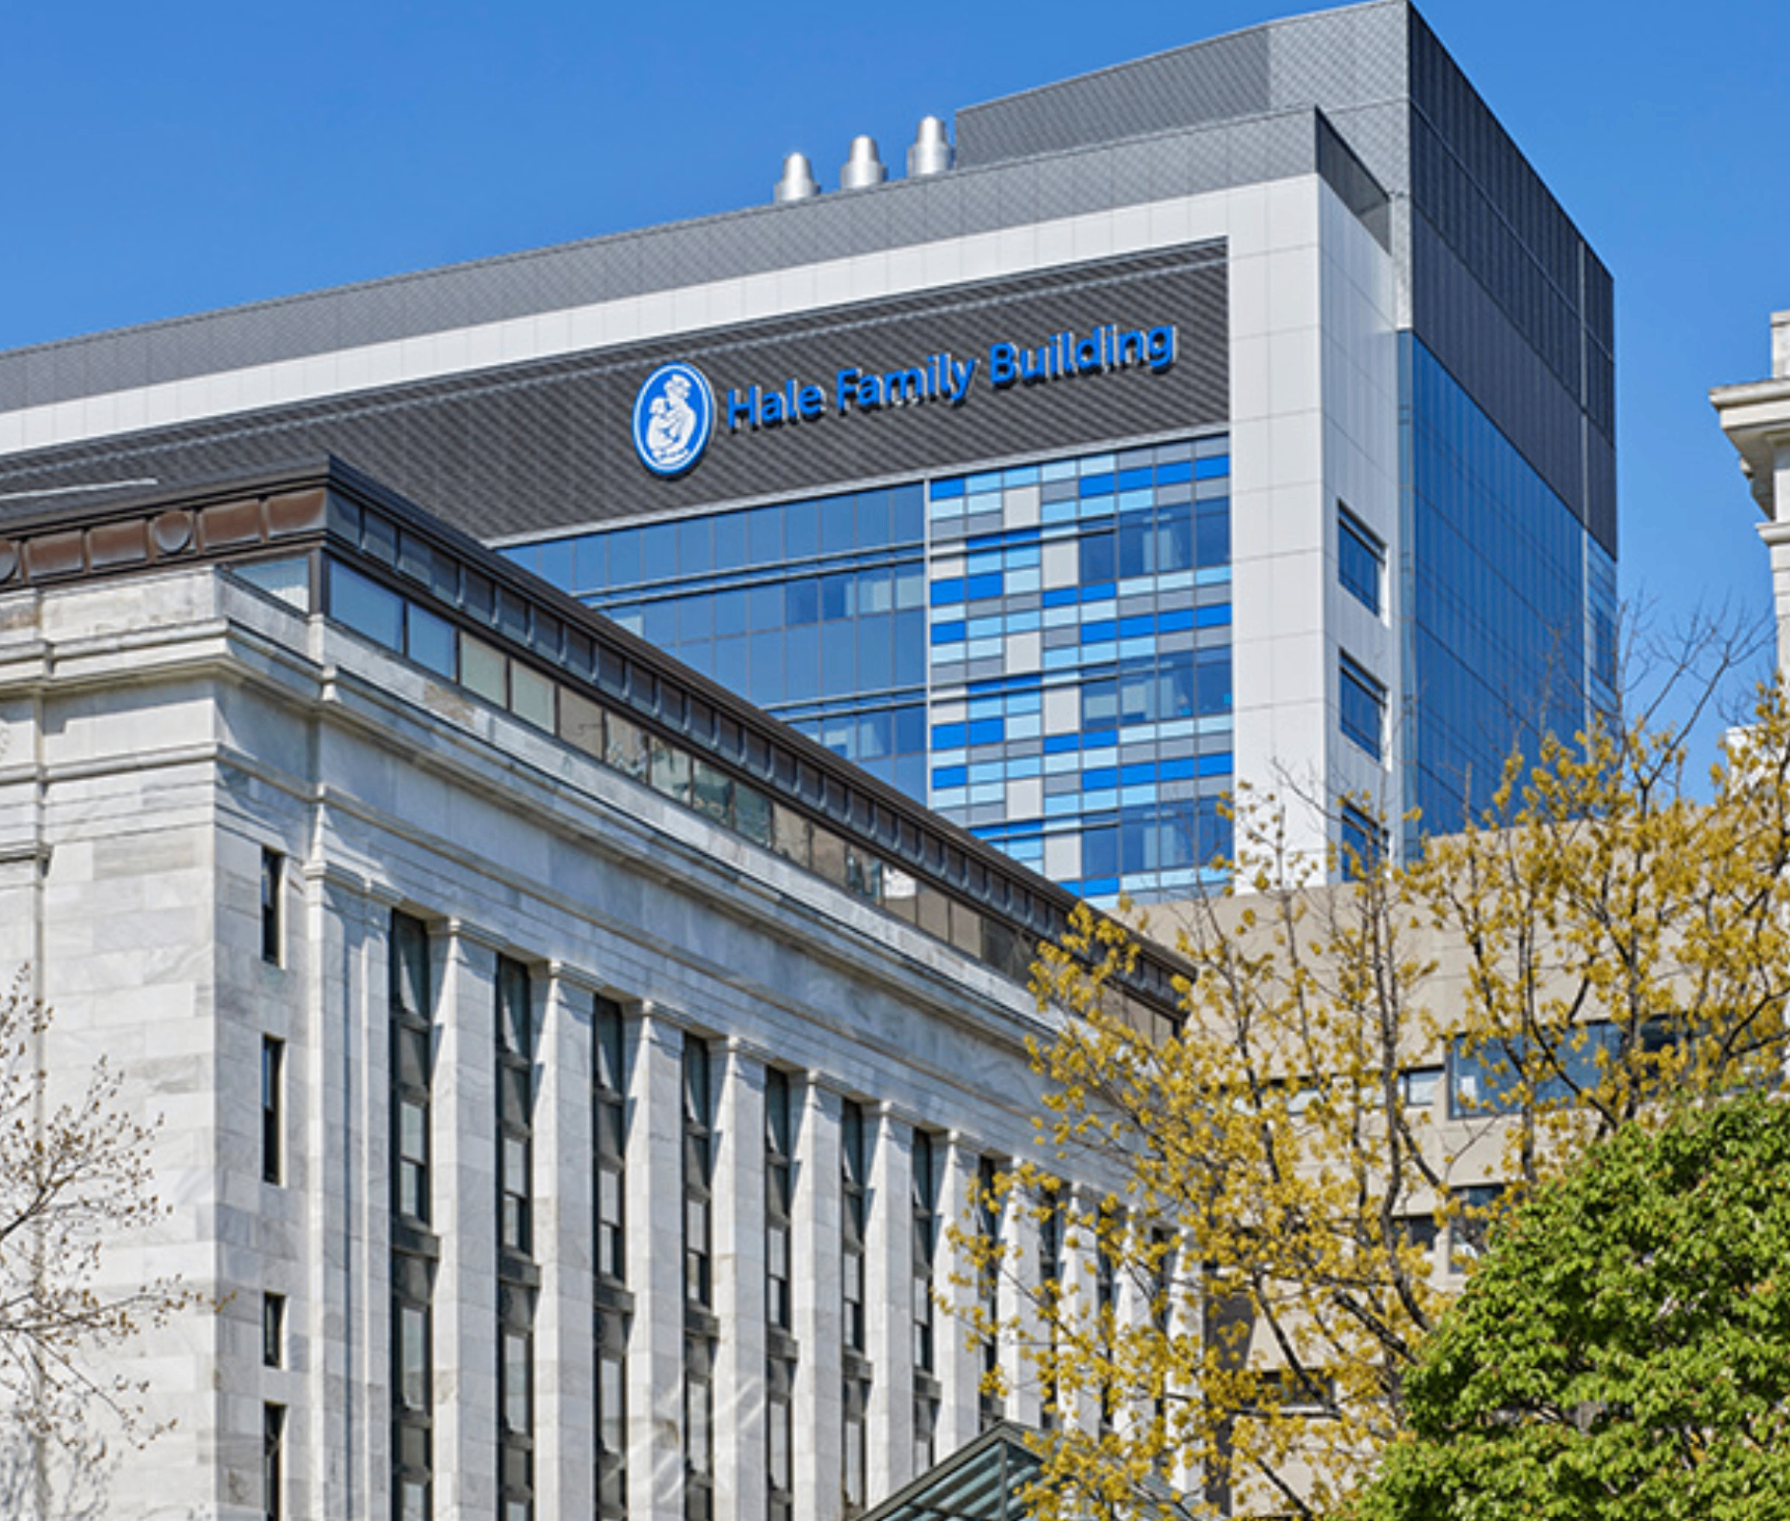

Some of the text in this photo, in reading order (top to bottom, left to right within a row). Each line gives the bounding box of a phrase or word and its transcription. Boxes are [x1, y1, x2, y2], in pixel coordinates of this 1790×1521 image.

[726, 324, 1176, 430] Hale Family Building
